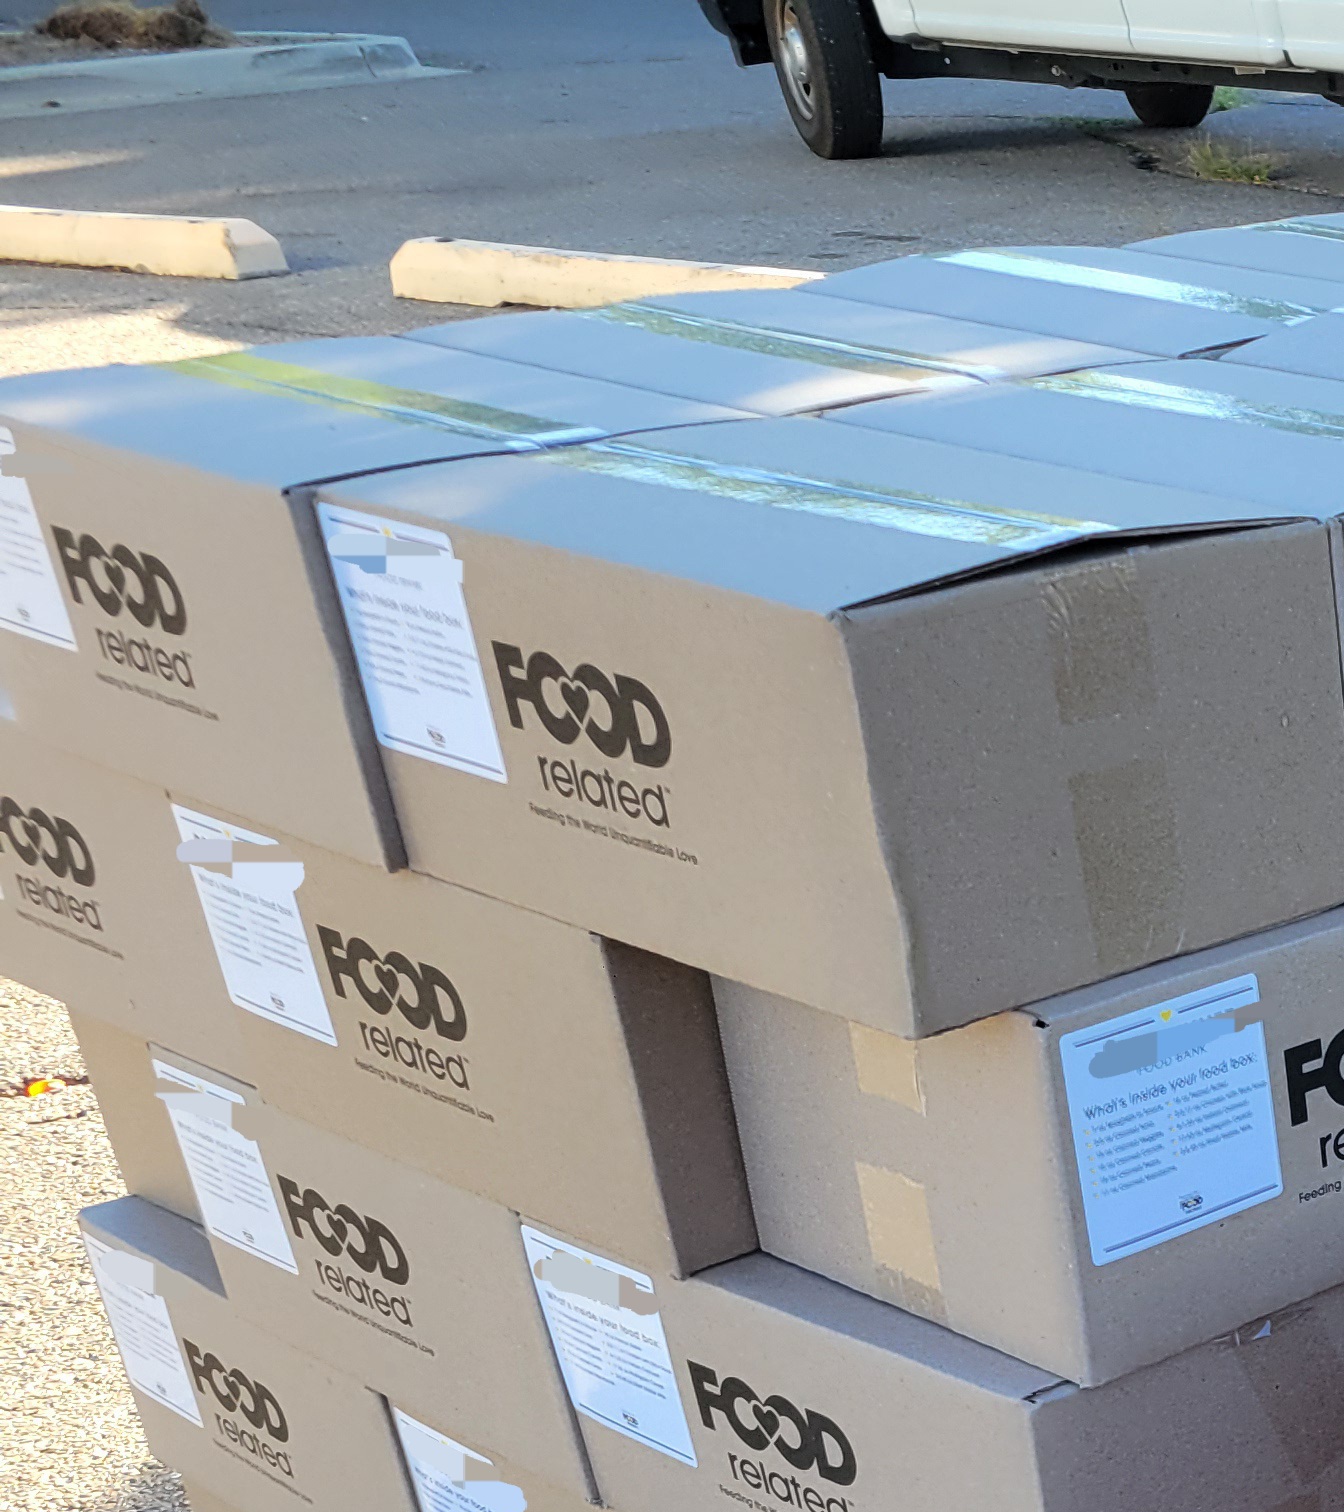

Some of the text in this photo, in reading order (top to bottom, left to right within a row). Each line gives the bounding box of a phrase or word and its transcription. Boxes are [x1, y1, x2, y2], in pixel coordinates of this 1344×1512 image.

[50, 524, 187, 635] FOOD
[95, 628, 195, 688] related
[491, 640, 672, 768] FOOD
[537, 755, 669, 828] related
[0, 796, 96, 887] OOD
[316, 924, 467, 1041] FOOD
[359, 1021, 469, 1090] related
[277, 1174, 409, 1285] FOOD
[1299, 1179, 1341, 1203] Feeding
[315, 1260, 413, 1327] related
[183, 1338, 289, 1442] FOOD
[687, 1359, 857, 1486] FOOD
[215, 1413, 294, 1478] related
